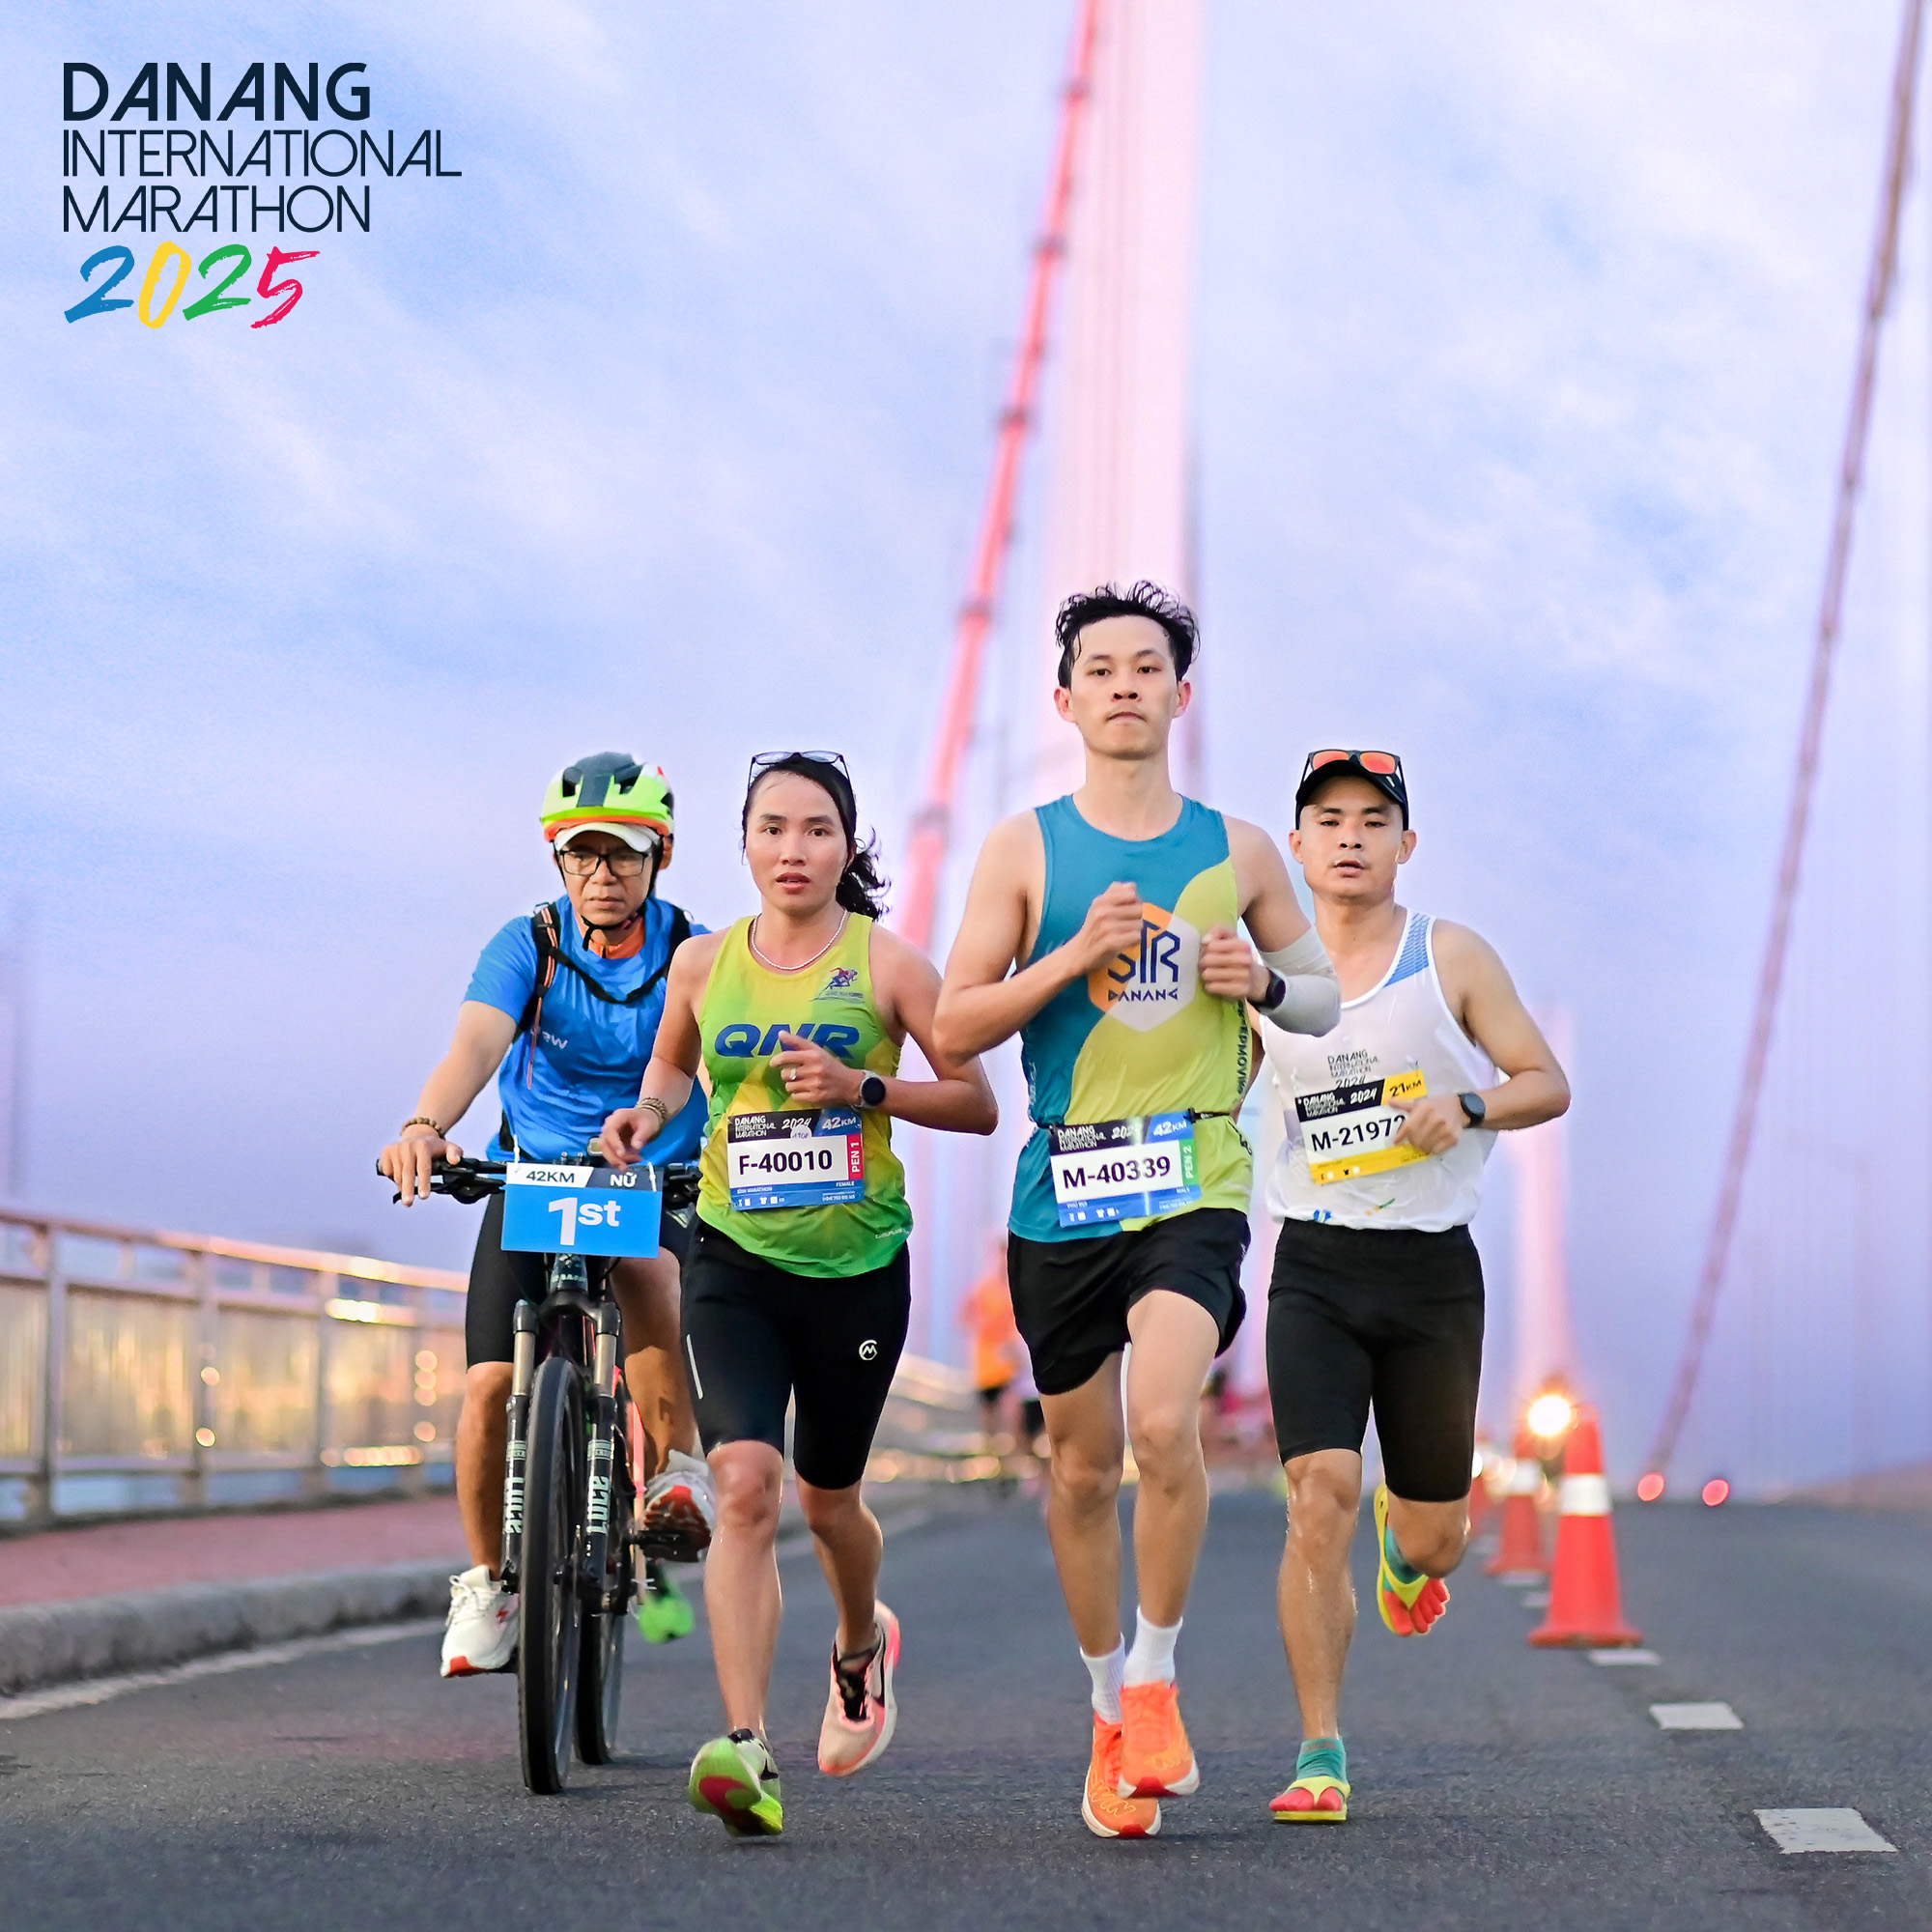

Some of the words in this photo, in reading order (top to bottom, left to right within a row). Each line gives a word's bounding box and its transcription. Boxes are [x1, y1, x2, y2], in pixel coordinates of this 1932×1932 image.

[1108, 987, 1179, 1002] DANANG
[715, 1023, 860, 1060] QNR
[1327, 1049, 1368, 1064] DANANG
[1389, 1079, 1422, 1097] 21KM
[1350, 1088, 1378, 1104] 2024
[735, 1116, 766, 1126] DANANG
[781, 1117, 812, 1129] 2024
[822, 1116, 857, 1130] 42KM
[1057, 1125, 1096, 1139] DANANG
[1152, 1121, 1187, 1137] 42KM
[739, 1150, 833, 1175] F-40010
[850, 1151, 861, 1173] PEN
[526, 1171, 576, 1183] 42KM
[610, 1172, 638, 1187] NỮ
[1063, 1156, 1171, 1189] M-40339
[548, 1197, 621, 1246] 1st
